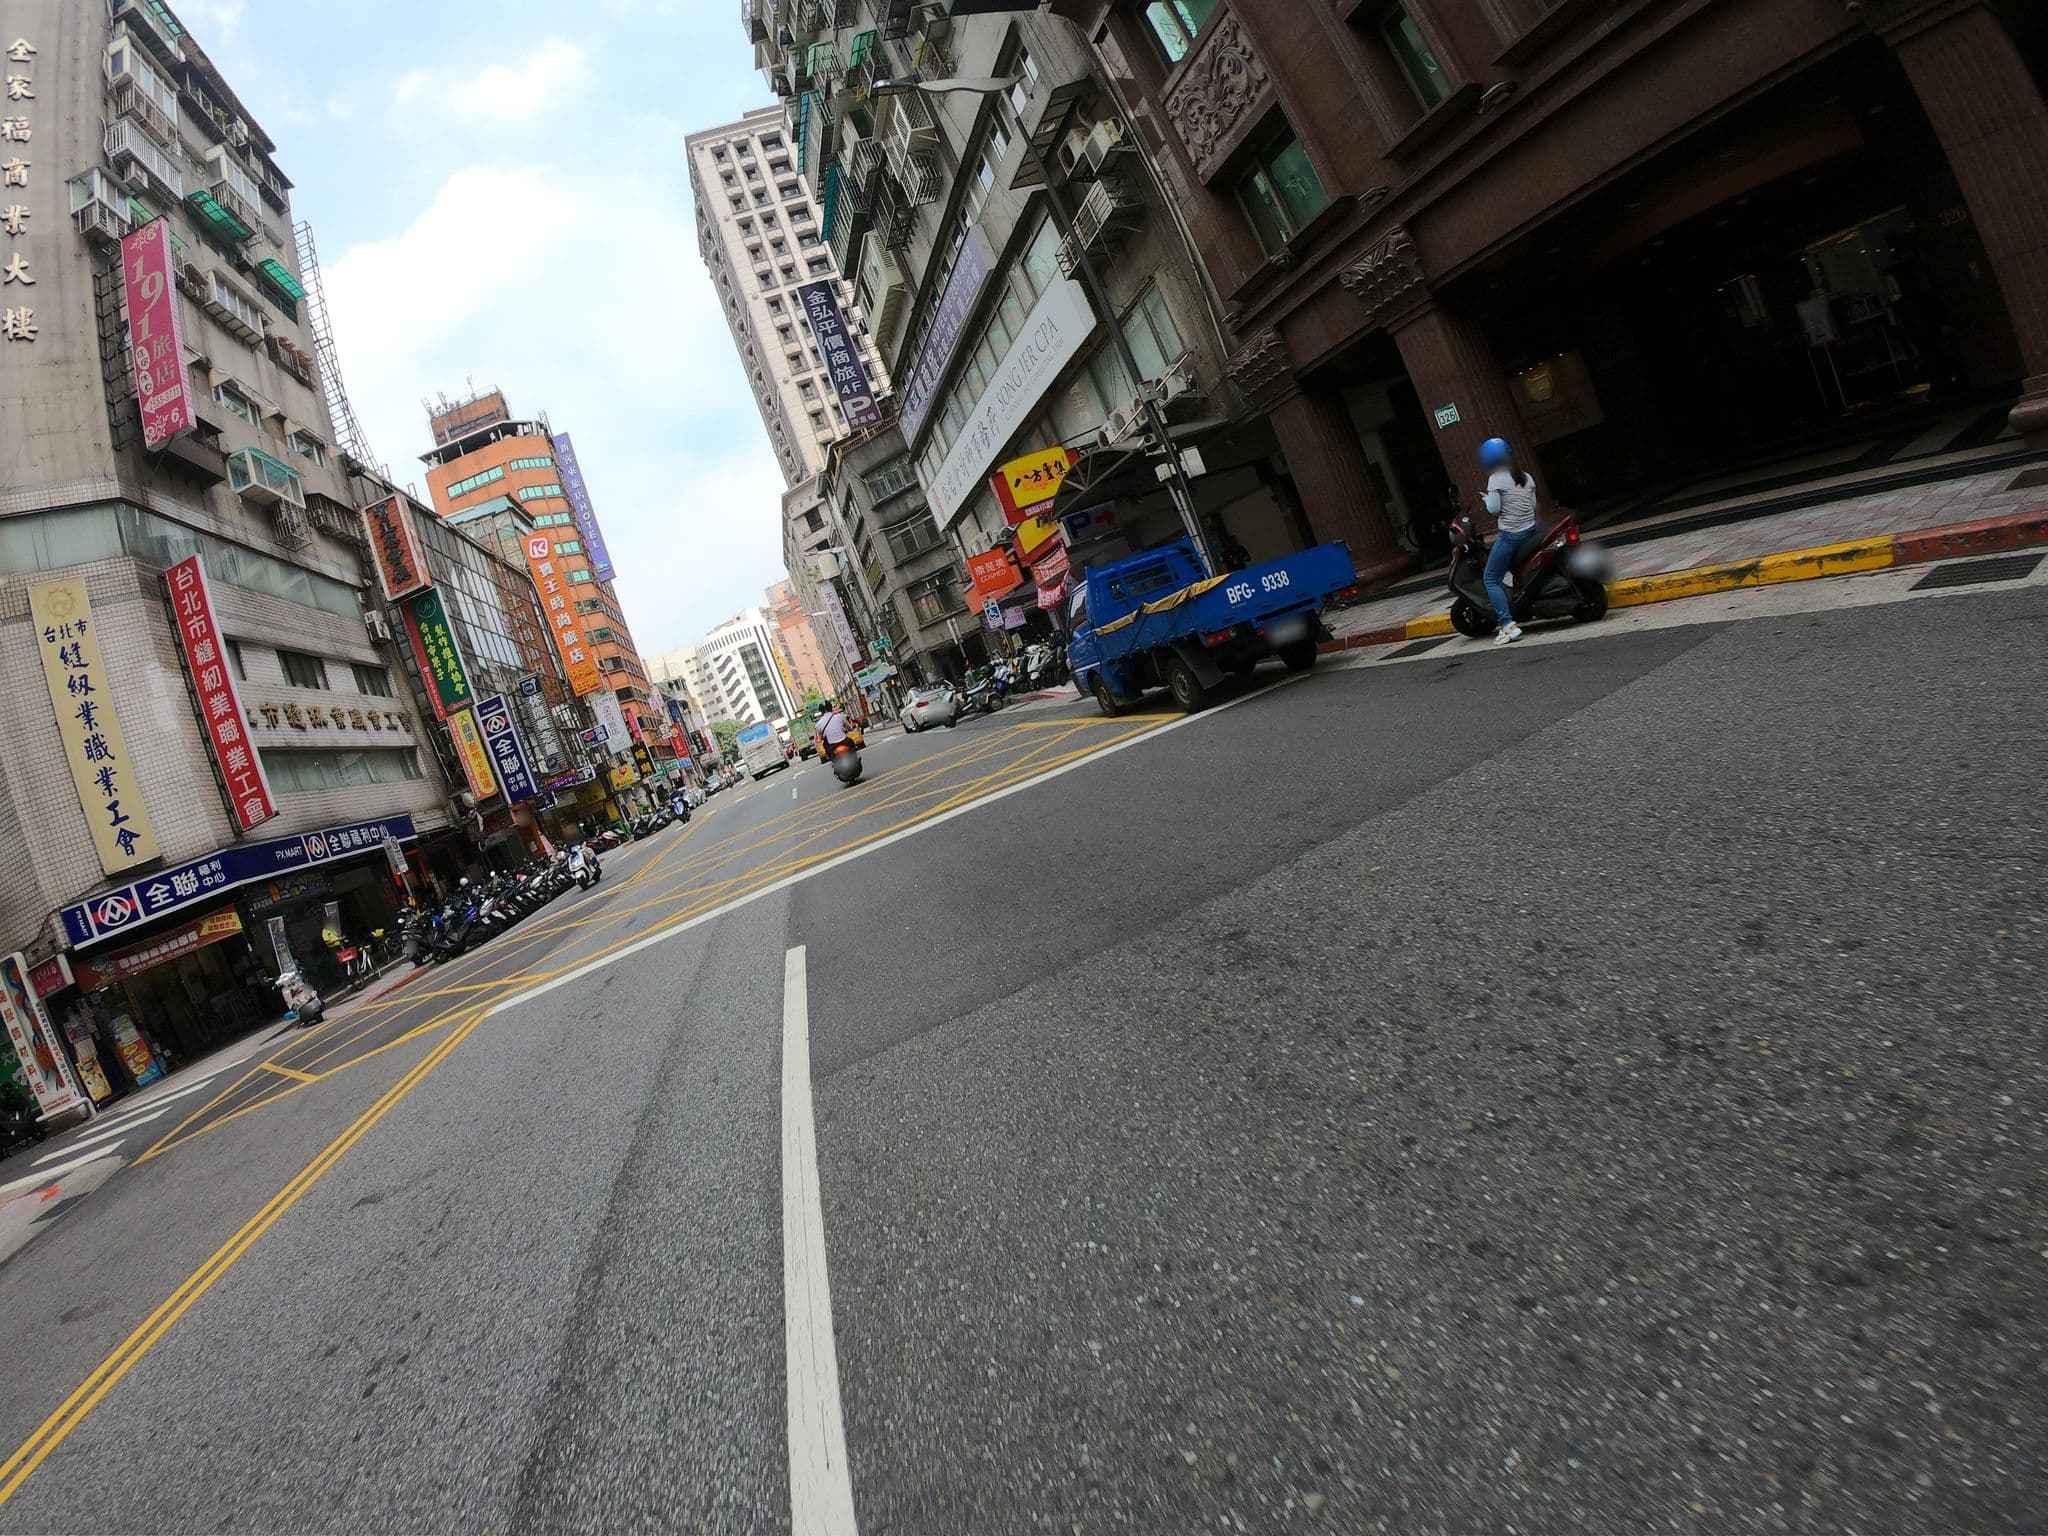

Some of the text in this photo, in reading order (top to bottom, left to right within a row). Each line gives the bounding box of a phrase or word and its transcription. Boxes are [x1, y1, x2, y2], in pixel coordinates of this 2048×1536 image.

[0, 36, 38, 342] 全家福商業大樓
[806, 290, 862, 395] 金弘平價商旅 4F
[930, 311, 948, 347] HOTEL
[996, 372, 1023, 412] SONG
[1034, 315, 1059, 359] CPA
[843, 395, 872, 419] P
[1440, 410, 1456, 425] 326
[1014, 460, 1067, 488] 八方雲集
[580, 503, 600, 549] HOTEL
[1067, 511, 1089, 540] P
[975, 558, 1005, 576] 康是美
[981, 569, 1007, 582] COSMED
[1261, 570, 1290, 592] 9338
[43, 619, 88, 643] 台北市
[176, 567, 266, 825] 台北市縫紉業職業工會
[59, 642, 141, 856] 縫紉業職業工會
[495, 738, 520, 774] 全聯
[507, 776, 519, 791] 中心
[329, 823, 390, 852] 全聯福利中心
[275, 845, 303, 861] PX MART
[198, 859, 222, 877] 福利
[202, 872, 226, 888] 中心
[146, 869, 199, 909] 全聯
[78, 918, 89, 937] MART
